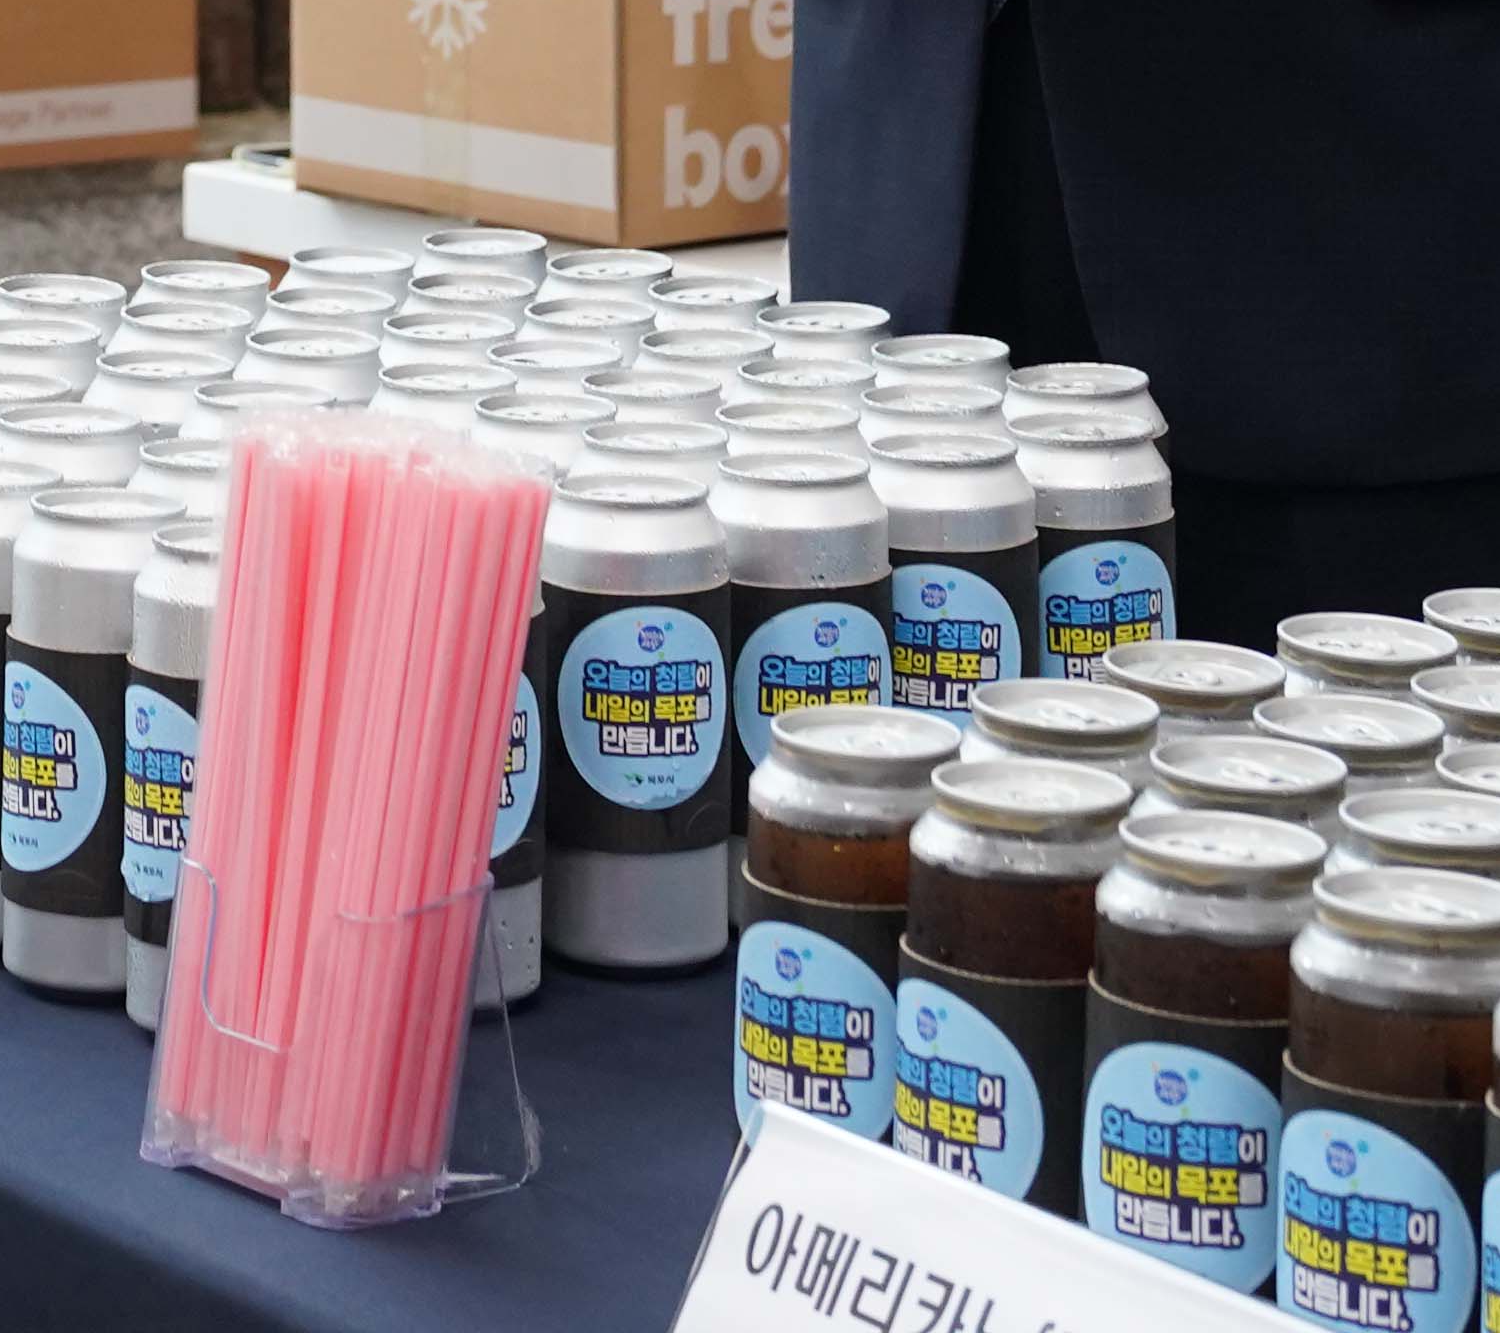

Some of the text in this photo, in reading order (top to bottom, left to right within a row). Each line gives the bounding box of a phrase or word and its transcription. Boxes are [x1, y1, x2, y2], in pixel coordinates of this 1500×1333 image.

[661, 105, 789, 209] bo
[893, 645, 931, 677] 일의
[584, 693, 650, 723] 내일의
[602, 724, 698, 755] 만듭니다.
[144, 782, 192, 817] 목포
[1101, 1146, 1172, 1200] 내일의
[1116, 1192, 1242, 1247] 만듭니다.
[744, 1203, 1075, 1333] 아메리카
